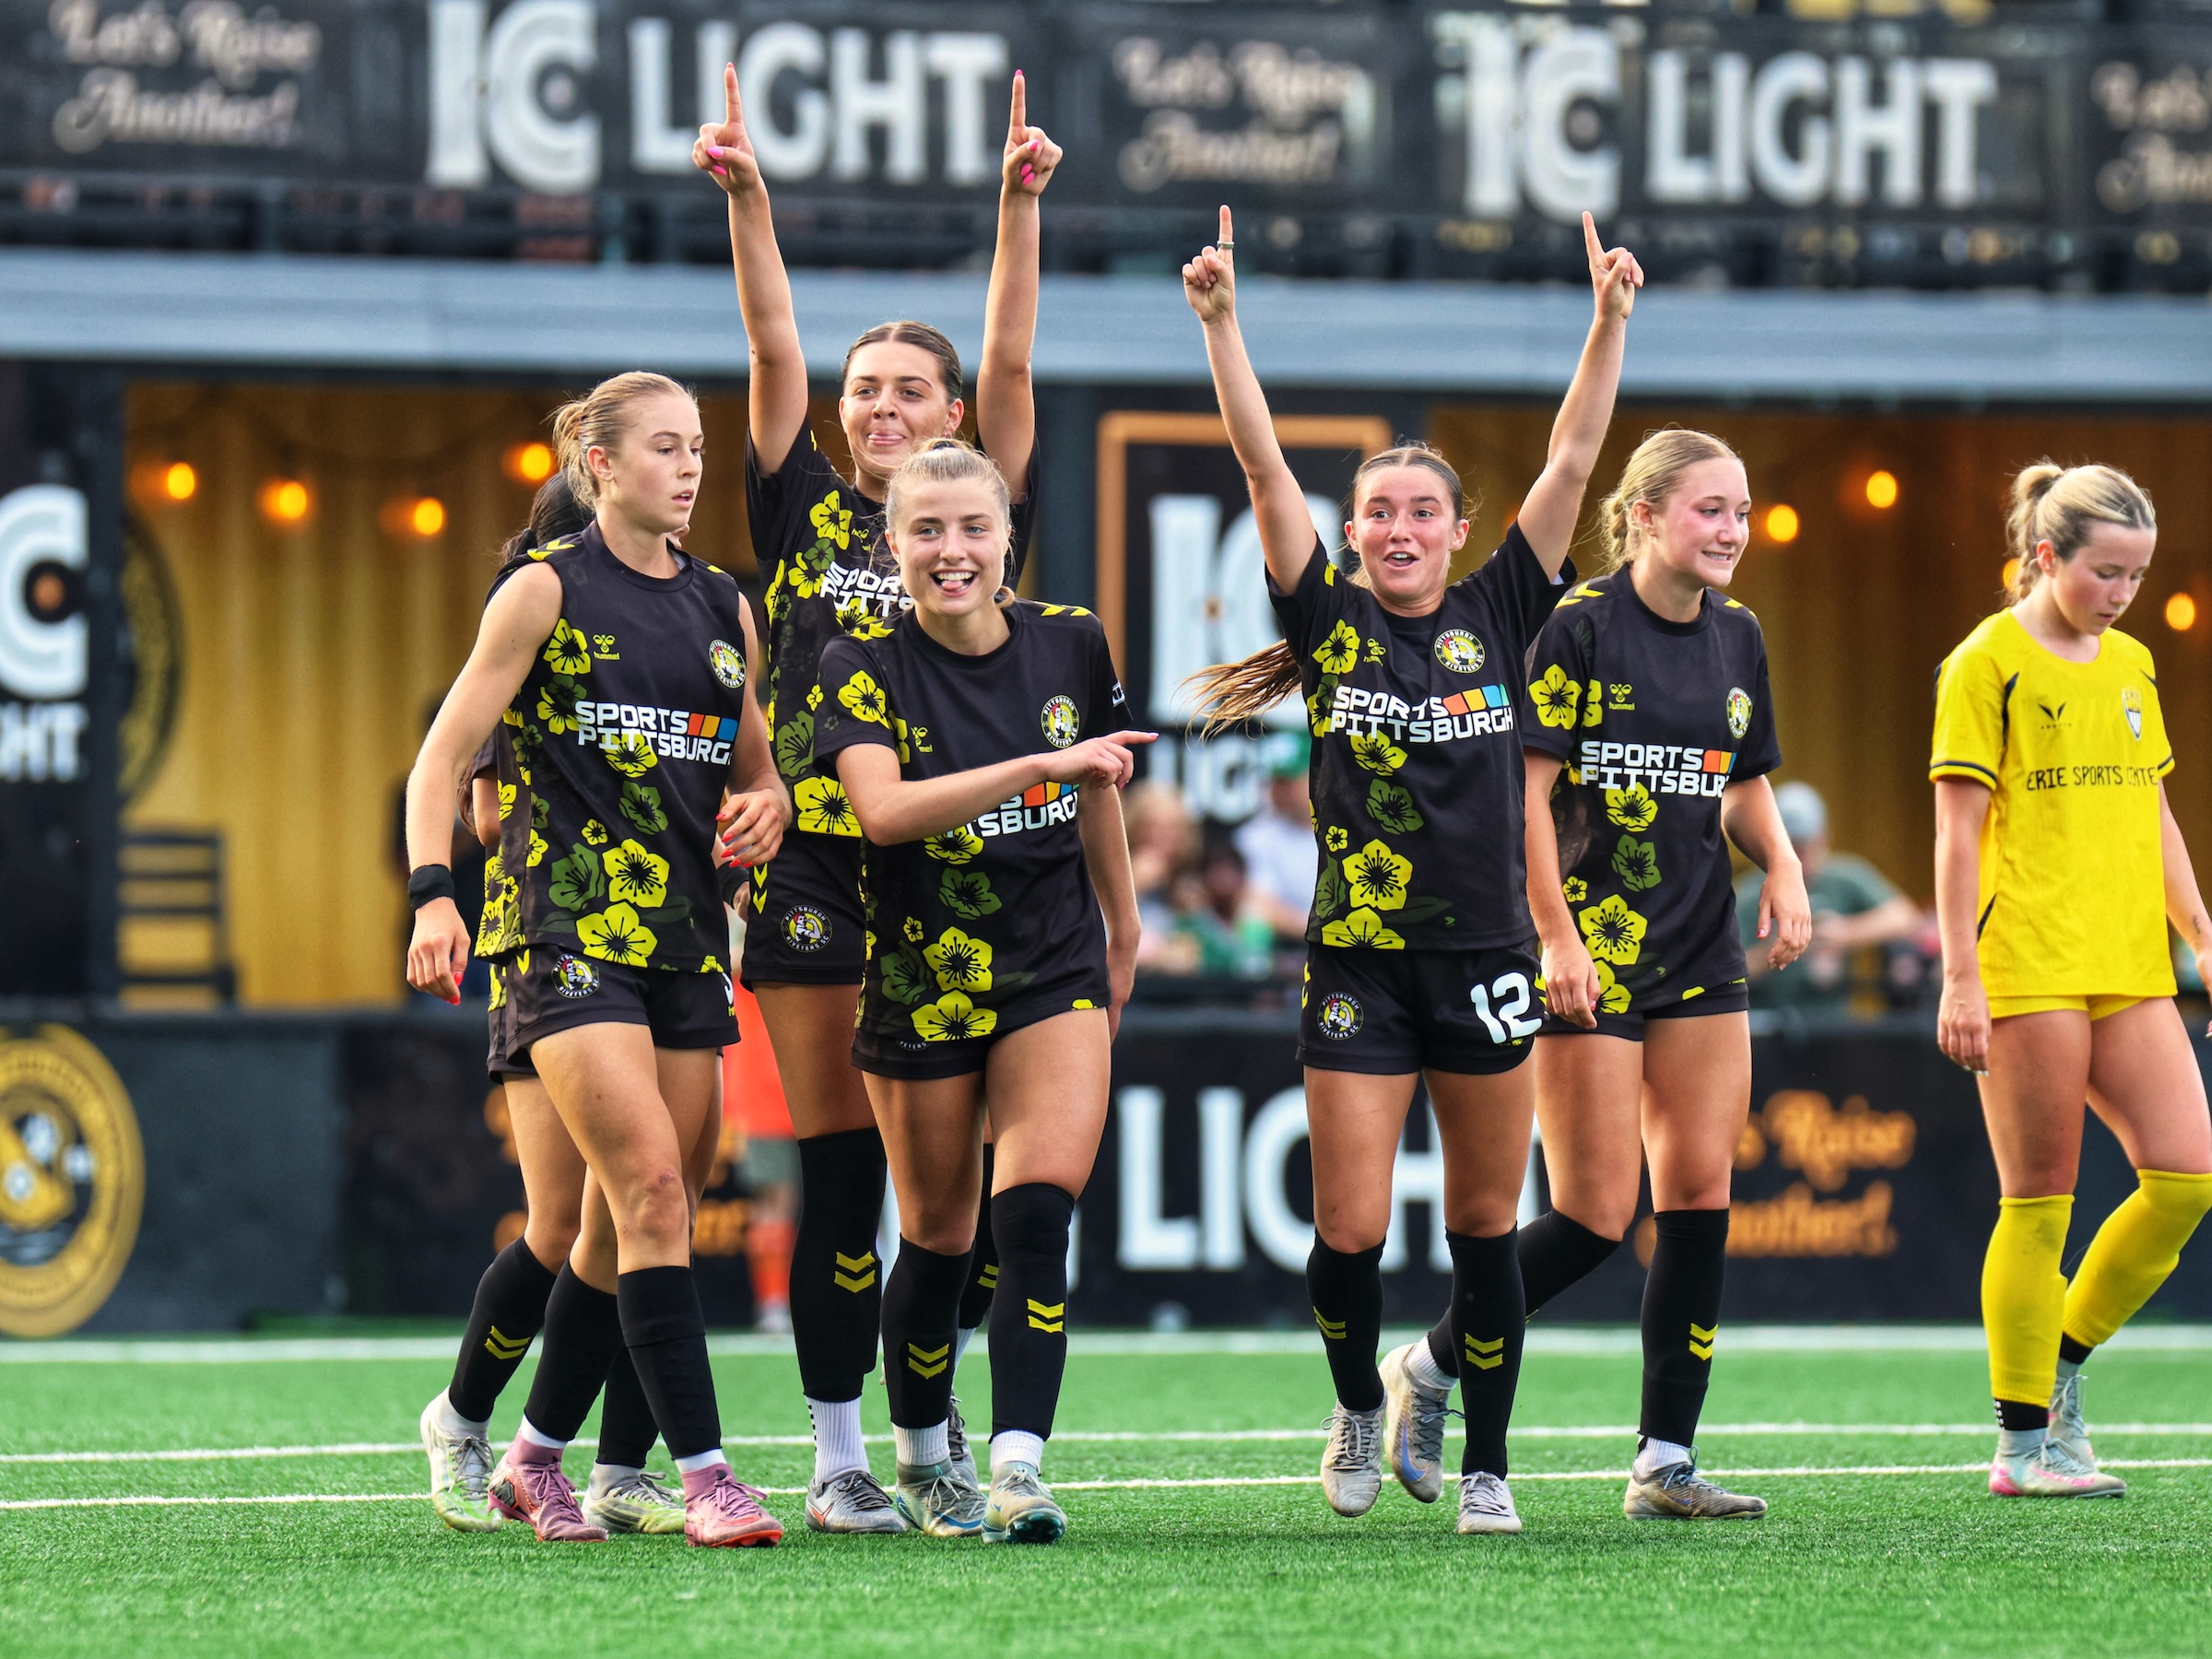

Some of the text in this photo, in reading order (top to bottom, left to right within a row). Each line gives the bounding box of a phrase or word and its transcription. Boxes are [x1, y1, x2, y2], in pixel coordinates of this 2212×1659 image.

[426, 0, 1006, 194] IC LIGHT
[1646, 50, 1996, 208] LIGHT
[830, 560, 902, 594] SPOR
[593, 651, 620, 661] hummel
[574, 700, 690, 735] SPORTS
[1333, 685, 1450, 721] SPORTS
[1608, 701, 1635, 711] hummel
[1329, 706, 1514, 744] PITTSBURGH
[577, 723, 734, 766] PITTSBURG
[1580, 740, 1704, 771] SPORTS
[1580, 763, 1730, 799] PITTSBUR
[2027, 765, 2159, 791] ERIE SPORTS CENTE
[784, 906, 827, 921] PITTSBURGH
[1322, 993, 1360, 1010] PITTSBURGH
[1469, 971, 1543, 1044] 12
[898, 1040, 927, 1050] VETERS
